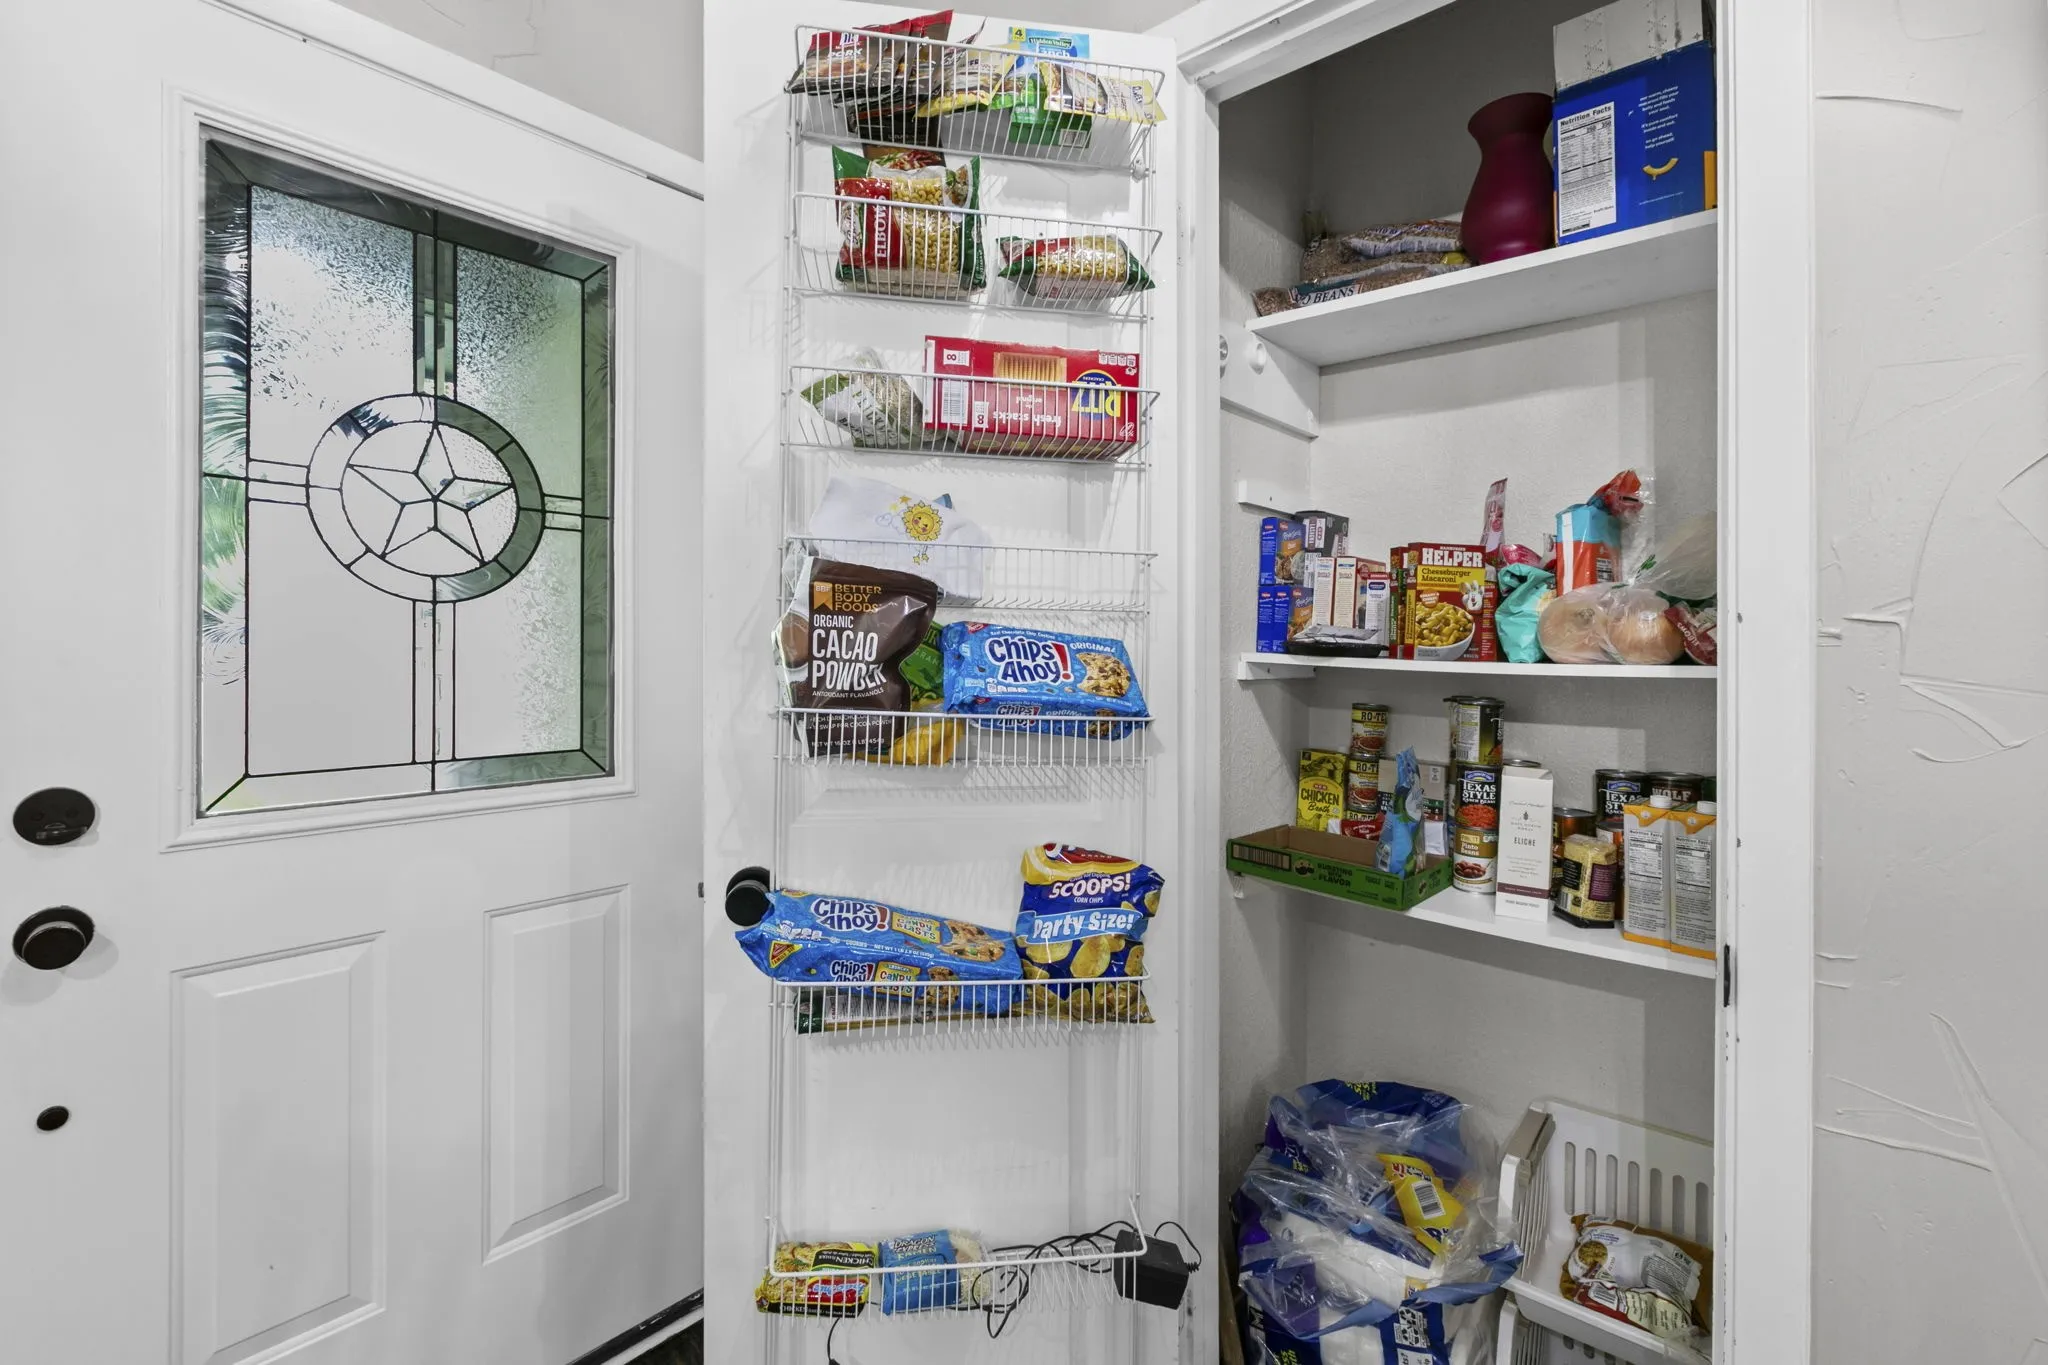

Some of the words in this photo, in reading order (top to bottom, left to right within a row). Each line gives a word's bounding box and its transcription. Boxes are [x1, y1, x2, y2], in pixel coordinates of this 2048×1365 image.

[1014, 29, 1023, 37] 4
[1030, 37, 1052, 45] Hidden
[1051, 39, 1071, 48] Valley
[827, 48, 862, 58] PORK
[1560, 112, 1590, 126] Nutrition
[1592, 105, 1612, 116] Facts
[1313, 286, 1354, 303] BEANS
[1072, 380, 1121, 418] RITZ
[993, 410, 1030, 422] stacks
[1032, 414, 1062, 428] fresh
[1422, 548, 1483, 567] HELPER
[1422, 568, 1471, 578] Cheeseburger
[1422, 575, 1456, 583] Macaroni
[834, 584, 882, 594] BETTER
[835, 593, 871, 602] BODY
[835, 603, 879, 613] FOODS
[813, 614, 854, 628] ORGANIC
[812, 628, 879, 661] CACAO
[988, 638, 1055, 663] Chips
[1070, 642, 1116, 653] ORIGINAL
[1000, 645, 1072, 684] Ahoy!
[812, 660, 887, 691] POWDER
[812, 690, 849, 698] ANTIOXIDANT
[850, 687, 884, 698] FLAVANOLS
[997, 705, 1034, 717] Chips
[1461, 779, 1496, 793] TEXAS
[1300, 788, 1340, 806] CHICKEN
[1463, 790, 1496, 800] STYLE
[1652, 788, 1692, 802] WOLF
[1308, 801, 1331, 814] Broth
[1462, 842, 1479, 850] Pinto
[1514, 837, 1536, 847] ELICHE
[1049, 873, 1131, 899] SCOOPS!
[1318, 874, 1351, 888] FLAVOR
[1073, 896, 1088, 904] CORN
[814, 899, 876, 916] Chips
[820, 907, 889, 931] Ahoy!
[1032, 913, 1085, 939] Party
[1088, 912, 1134, 931] Size!
[831, 960, 867, 976] Chips
[894, 1236, 936, 1248] DRAGON
[836, 1256, 874, 1267] CHICKEN
[812, 1282, 866, 1296] Indomie
